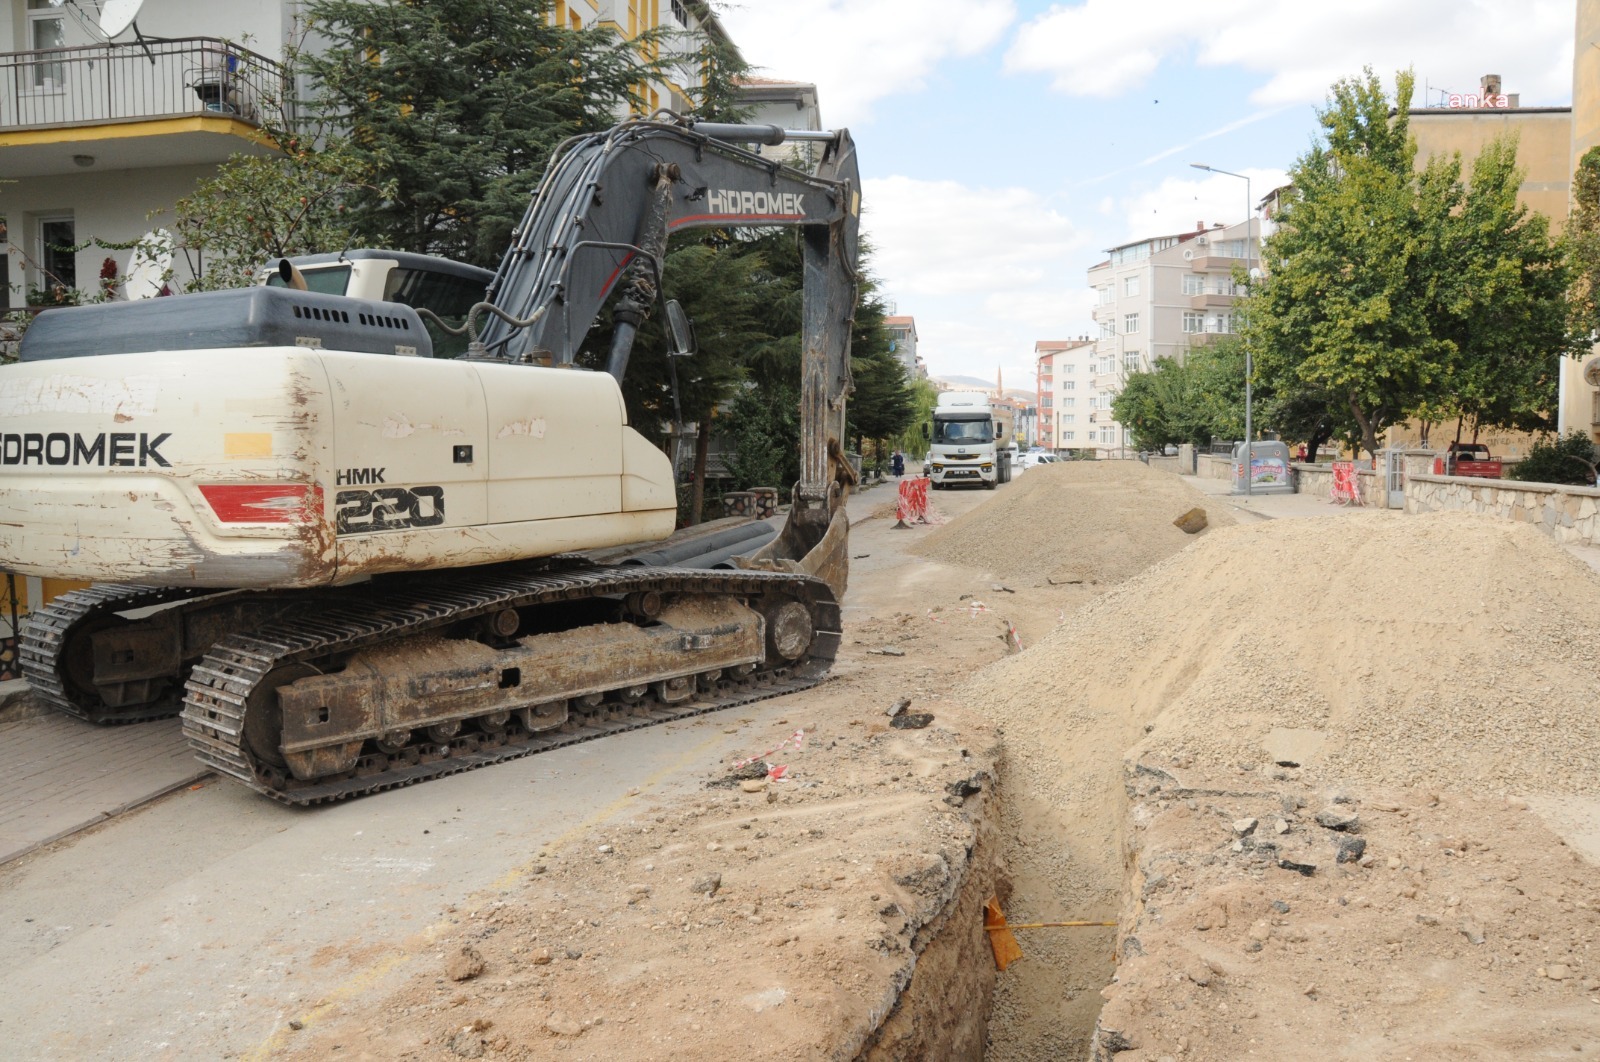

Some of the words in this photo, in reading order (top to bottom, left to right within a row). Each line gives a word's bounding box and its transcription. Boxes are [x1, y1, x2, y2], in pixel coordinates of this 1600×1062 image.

[1449, 87, 1509, 108] anka
[336, 467, 386, 485] HMK
[336, 485, 445, 535] 220
